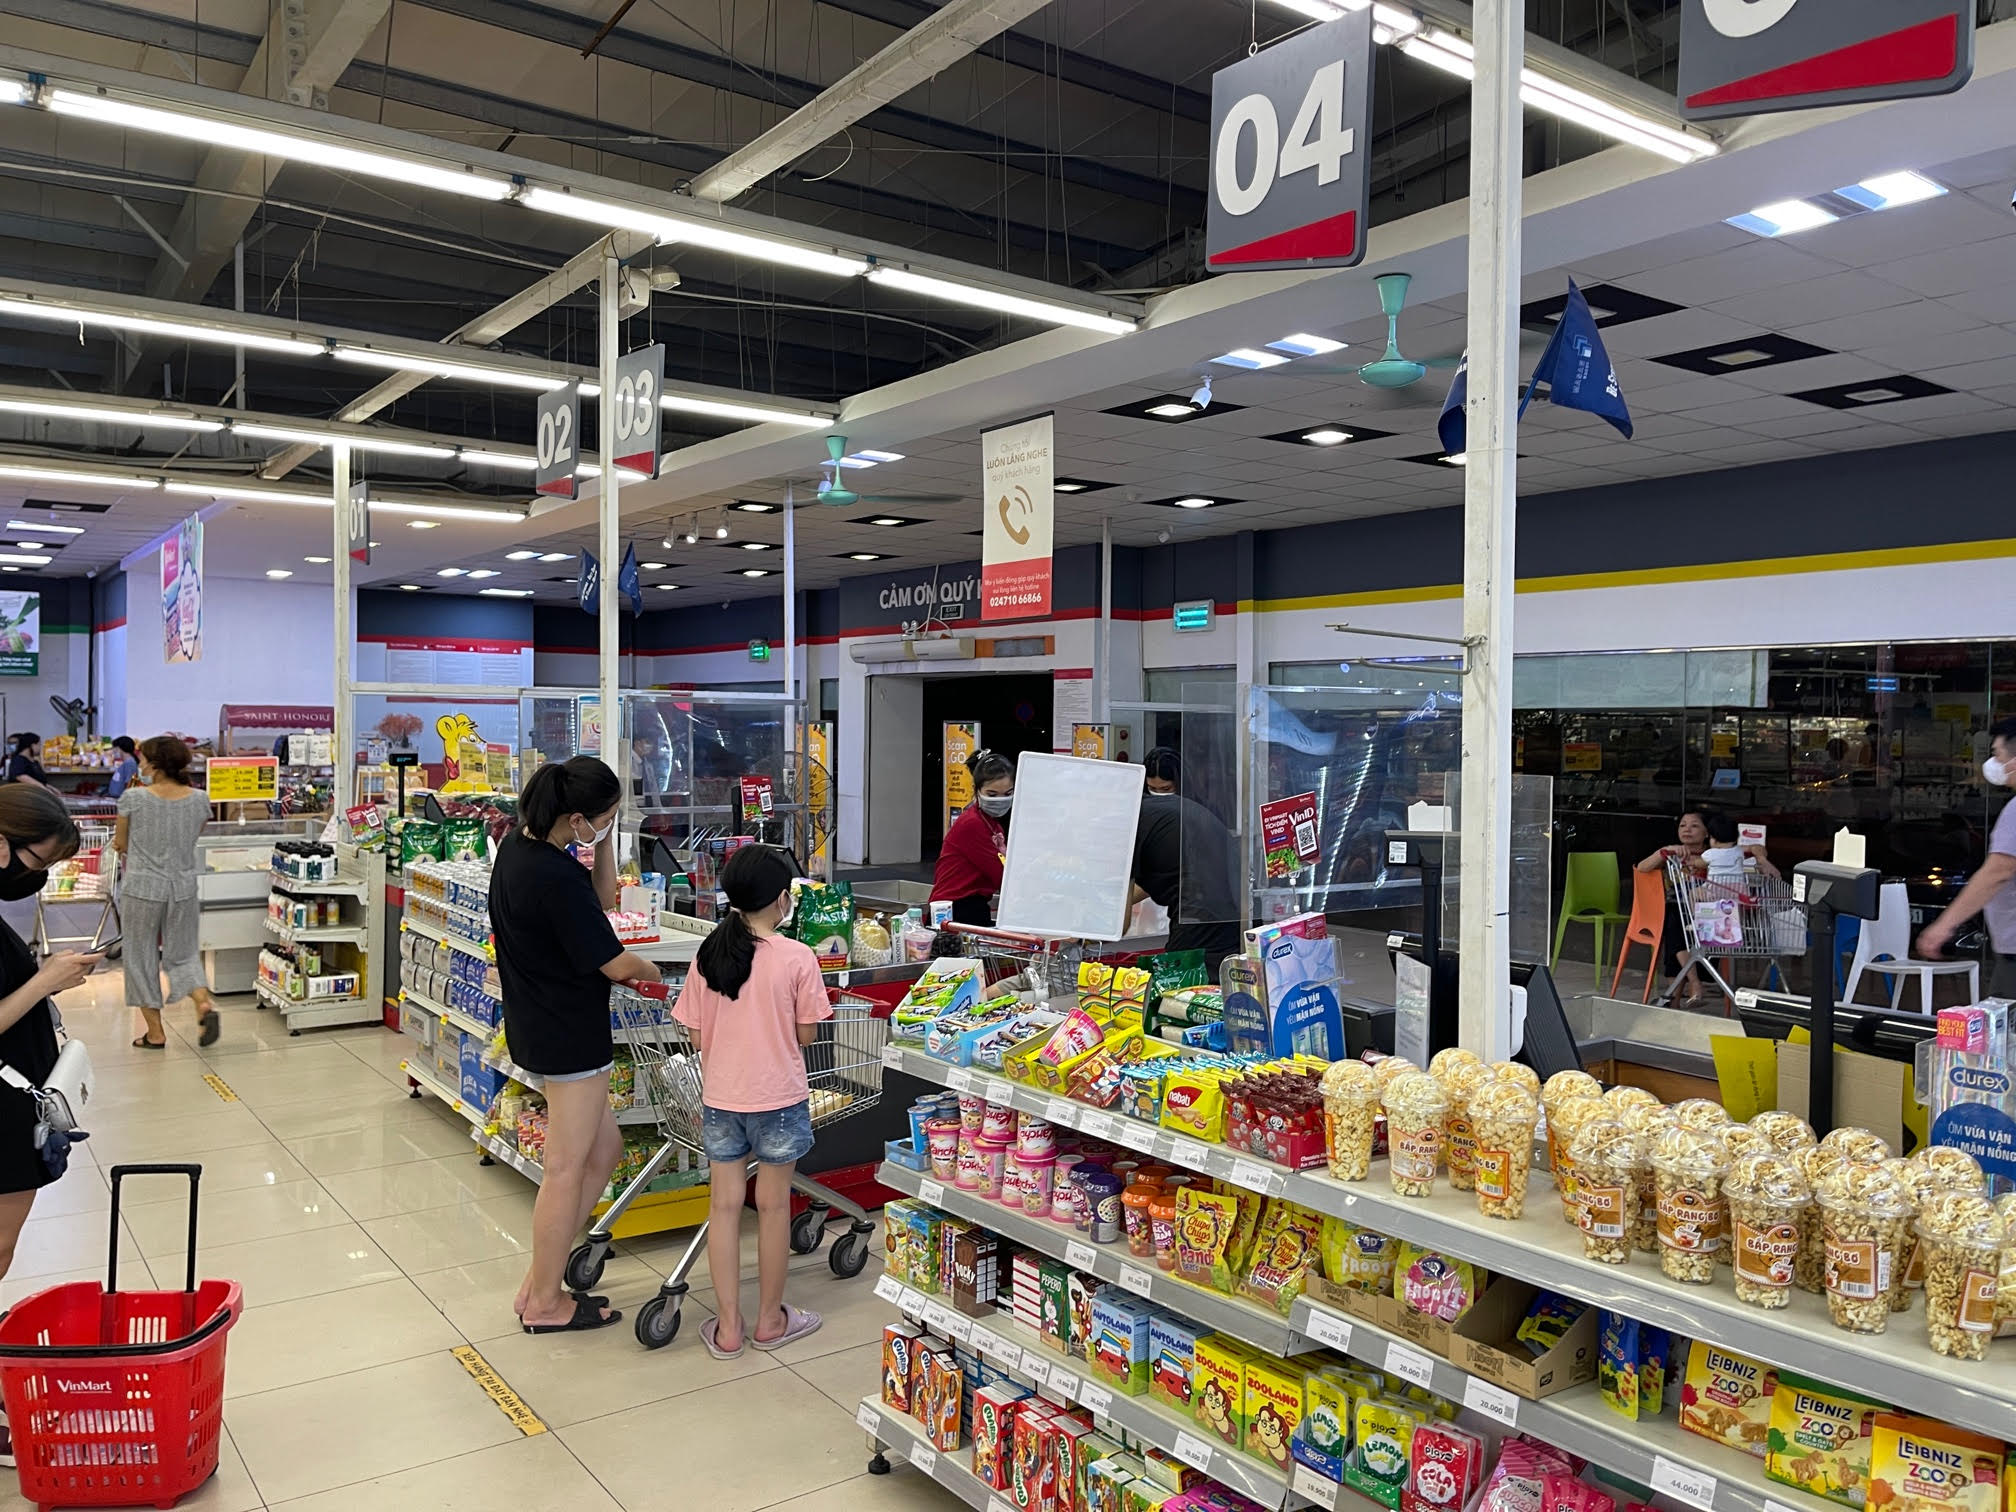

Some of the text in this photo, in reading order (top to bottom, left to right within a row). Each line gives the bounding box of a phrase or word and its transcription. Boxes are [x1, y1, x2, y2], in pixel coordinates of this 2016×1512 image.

[1215, 59, 1354, 216] 04
[615, 369, 654, 440] 03
[537, 404, 572, 469] 02
[1027, 447, 1048, 459] NGHE
[350, 498, 365, 541] 01
[880, 583, 911, 609] CẢM
[914, 582, 937, 606] ƠN
[940, 575, 975, 603] QUÝ
[989, 592, 1042, 607] 024710 66866
[243, 712, 278, 721] SAINT
[948, 740, 967, 750] Scan
[1078, 740, 1098, 750] Scan
[1289, 807, 1314, 826] VinID
[1230, 970, 1257, 983] durex
[1938, 1027, 1966, 1039] BEST FIT
[1953, 1068, 2006, 1093] durex
[1188, 1215, 1211, 1231] Chupa
[1042, 1273, 1061, 1292] PEPERO
[1092, 1308, 1132, 1335] AUTOLAND
[1150, 1327, 1194, 1355] AUTOLAND
[1319, 1329, 1339, 1344] 20.000
[1195, 1353, 1239, 1383] ZOOLAND
[1399, 1364, 1421, 1379] 20.000
[1706, 1349, 1758, 1381] LEIBNIZ
[57, 1379, 112, 1393] VinMart
[1247, 1377, 1299, 1408] ZOOLAND
[1712, 1374, 1740, 1394] ZOO
[1480, 1400, 1503, 1415] 20.000
[1794, 1393, 1854, 1421] LEIBNIZ
[1312, 1412, 1339, 1435] LEMON
[1371, 1422, 1389, 1434] play
[1801, 1417, 1834, 1436] ZOO
[1365, 1439, 1403, 1459] LEMON
[1425, 1446, 1443, 1458] play
[1898, 1436, 1963, 1469] LEIBNIZ
[1422, 1468, 1451, 1487] COLA
[1908, 1462, 1945, 1484] ZOO
[1670, 1479, 1699, 1496] 44.000
